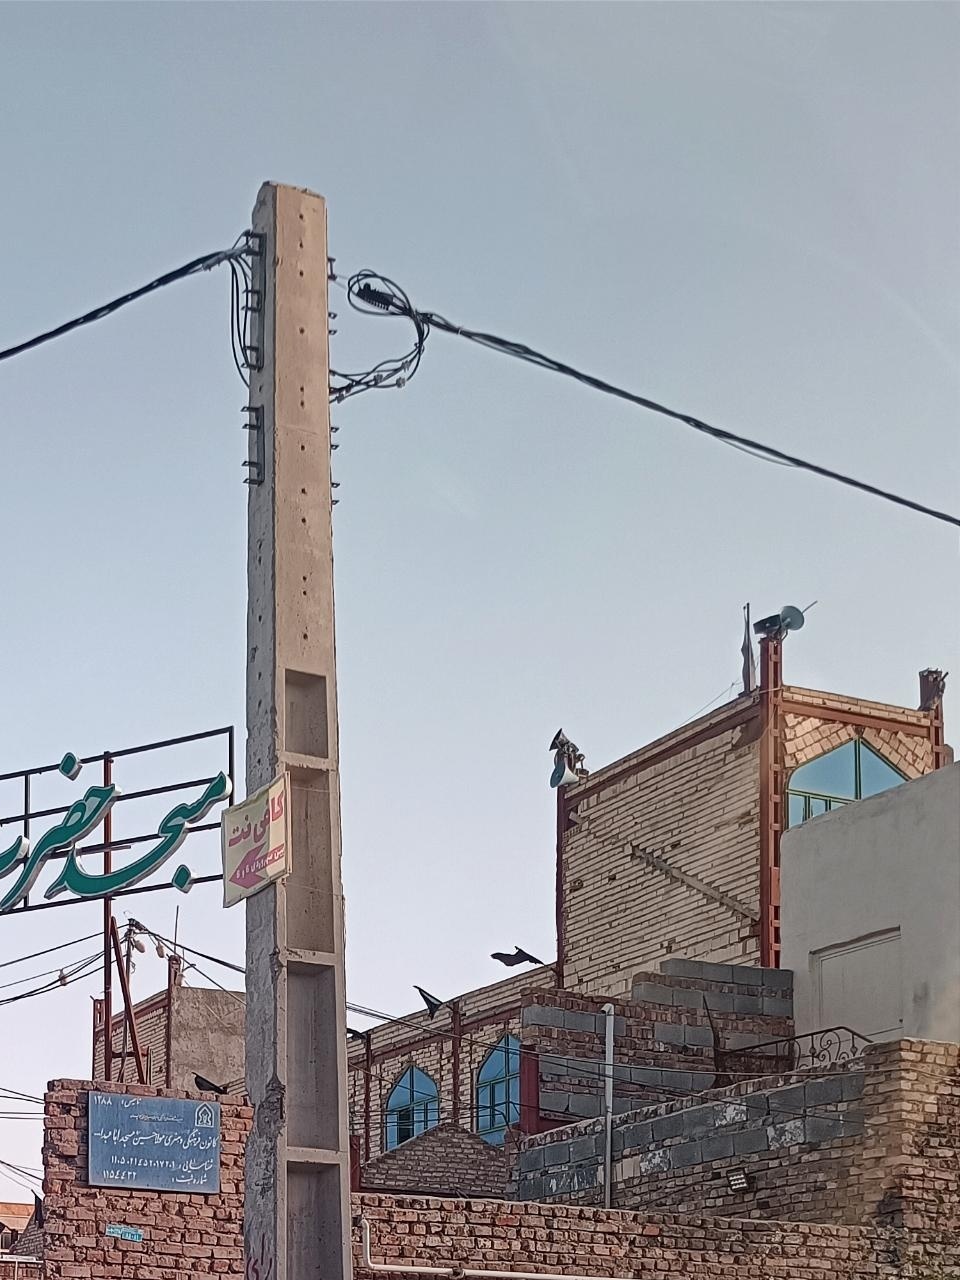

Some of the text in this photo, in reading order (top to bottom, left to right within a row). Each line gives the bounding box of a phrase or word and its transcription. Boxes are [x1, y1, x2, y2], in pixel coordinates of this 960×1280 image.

[44, 771, 231, 899] مسجد
[228, 790, 285, 848] کافی نت
[199, 1136, 220, 1150] کانون
